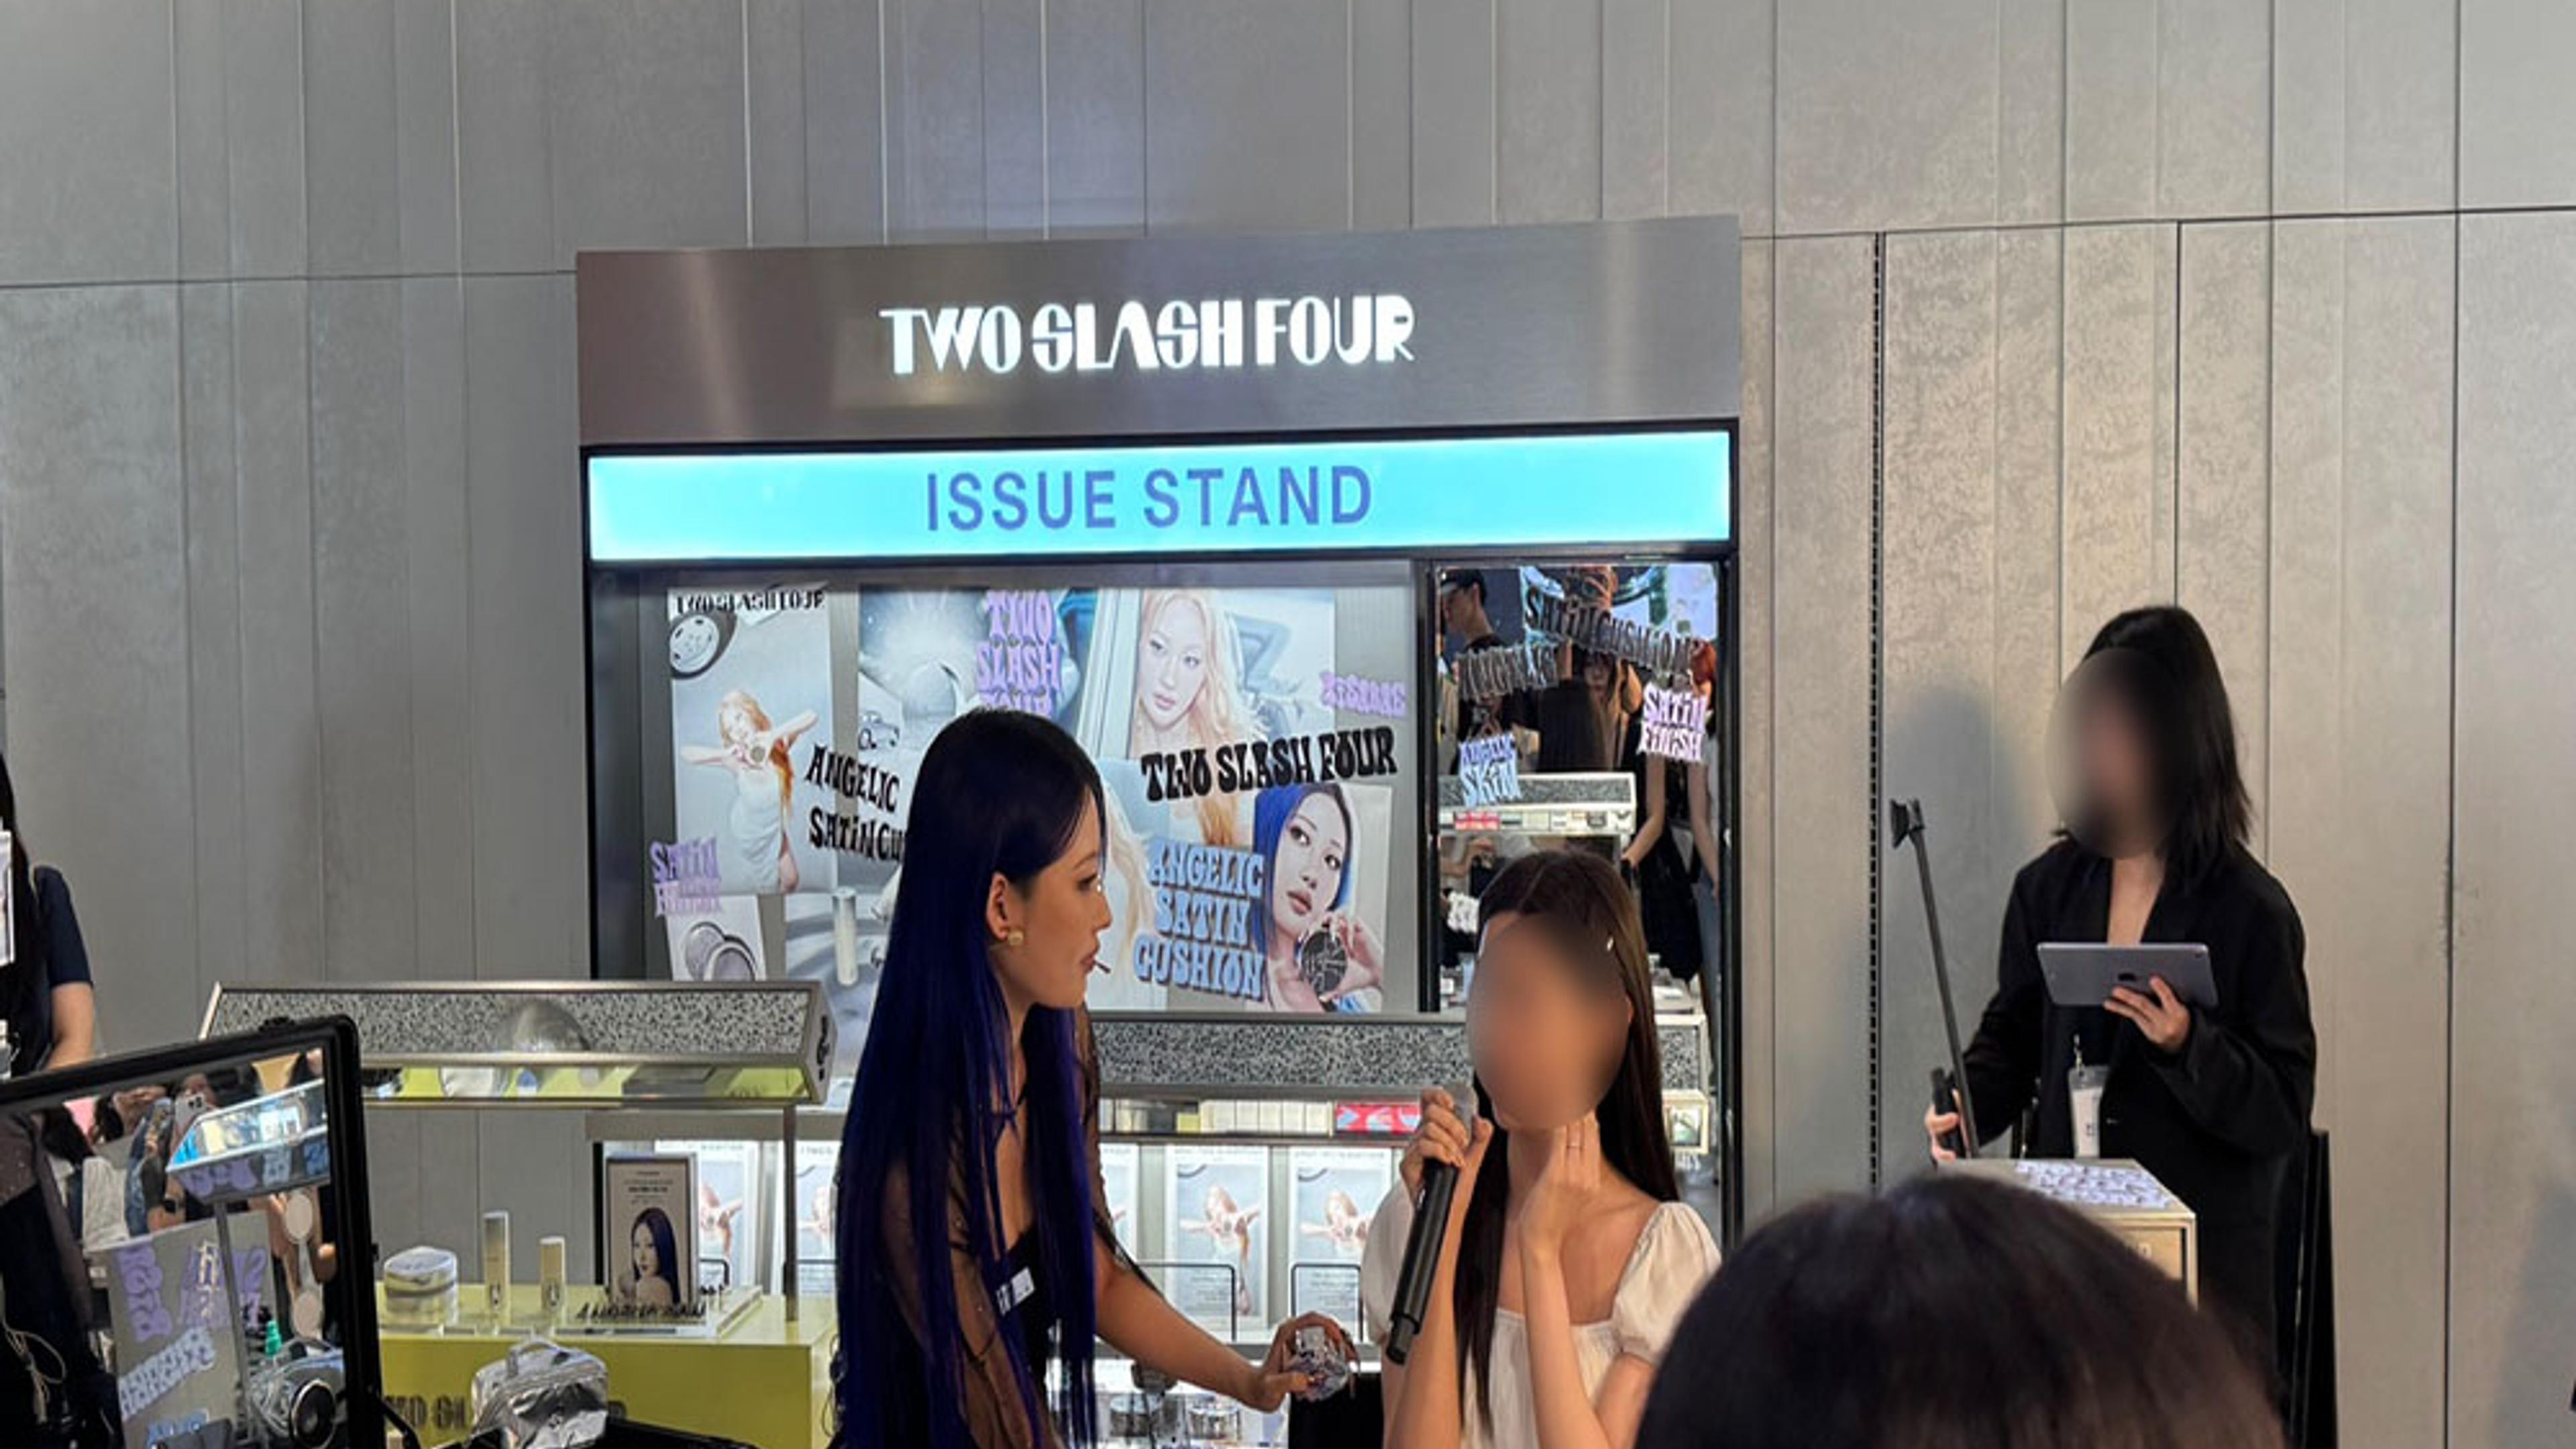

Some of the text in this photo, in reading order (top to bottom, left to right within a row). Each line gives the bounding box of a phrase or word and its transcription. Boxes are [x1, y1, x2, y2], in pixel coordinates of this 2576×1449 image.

[879, 295, 1414, 374] TWO SLASH FOUR
[927, 466, 1371, 531] ISSUE STAND
[804, 744, 900, 814] ANGELIC
[1141, 748, 1212, 802] TWO
[1216, 737, 1315, 793] SLASH
[1318, 726, 1398, 782] FOUR
[1147, 839, 1265, 900] ANGELIC
[1155, 889, 1252, 950] SATIN
[1134, 933, 1266, 1002] CUSHION
